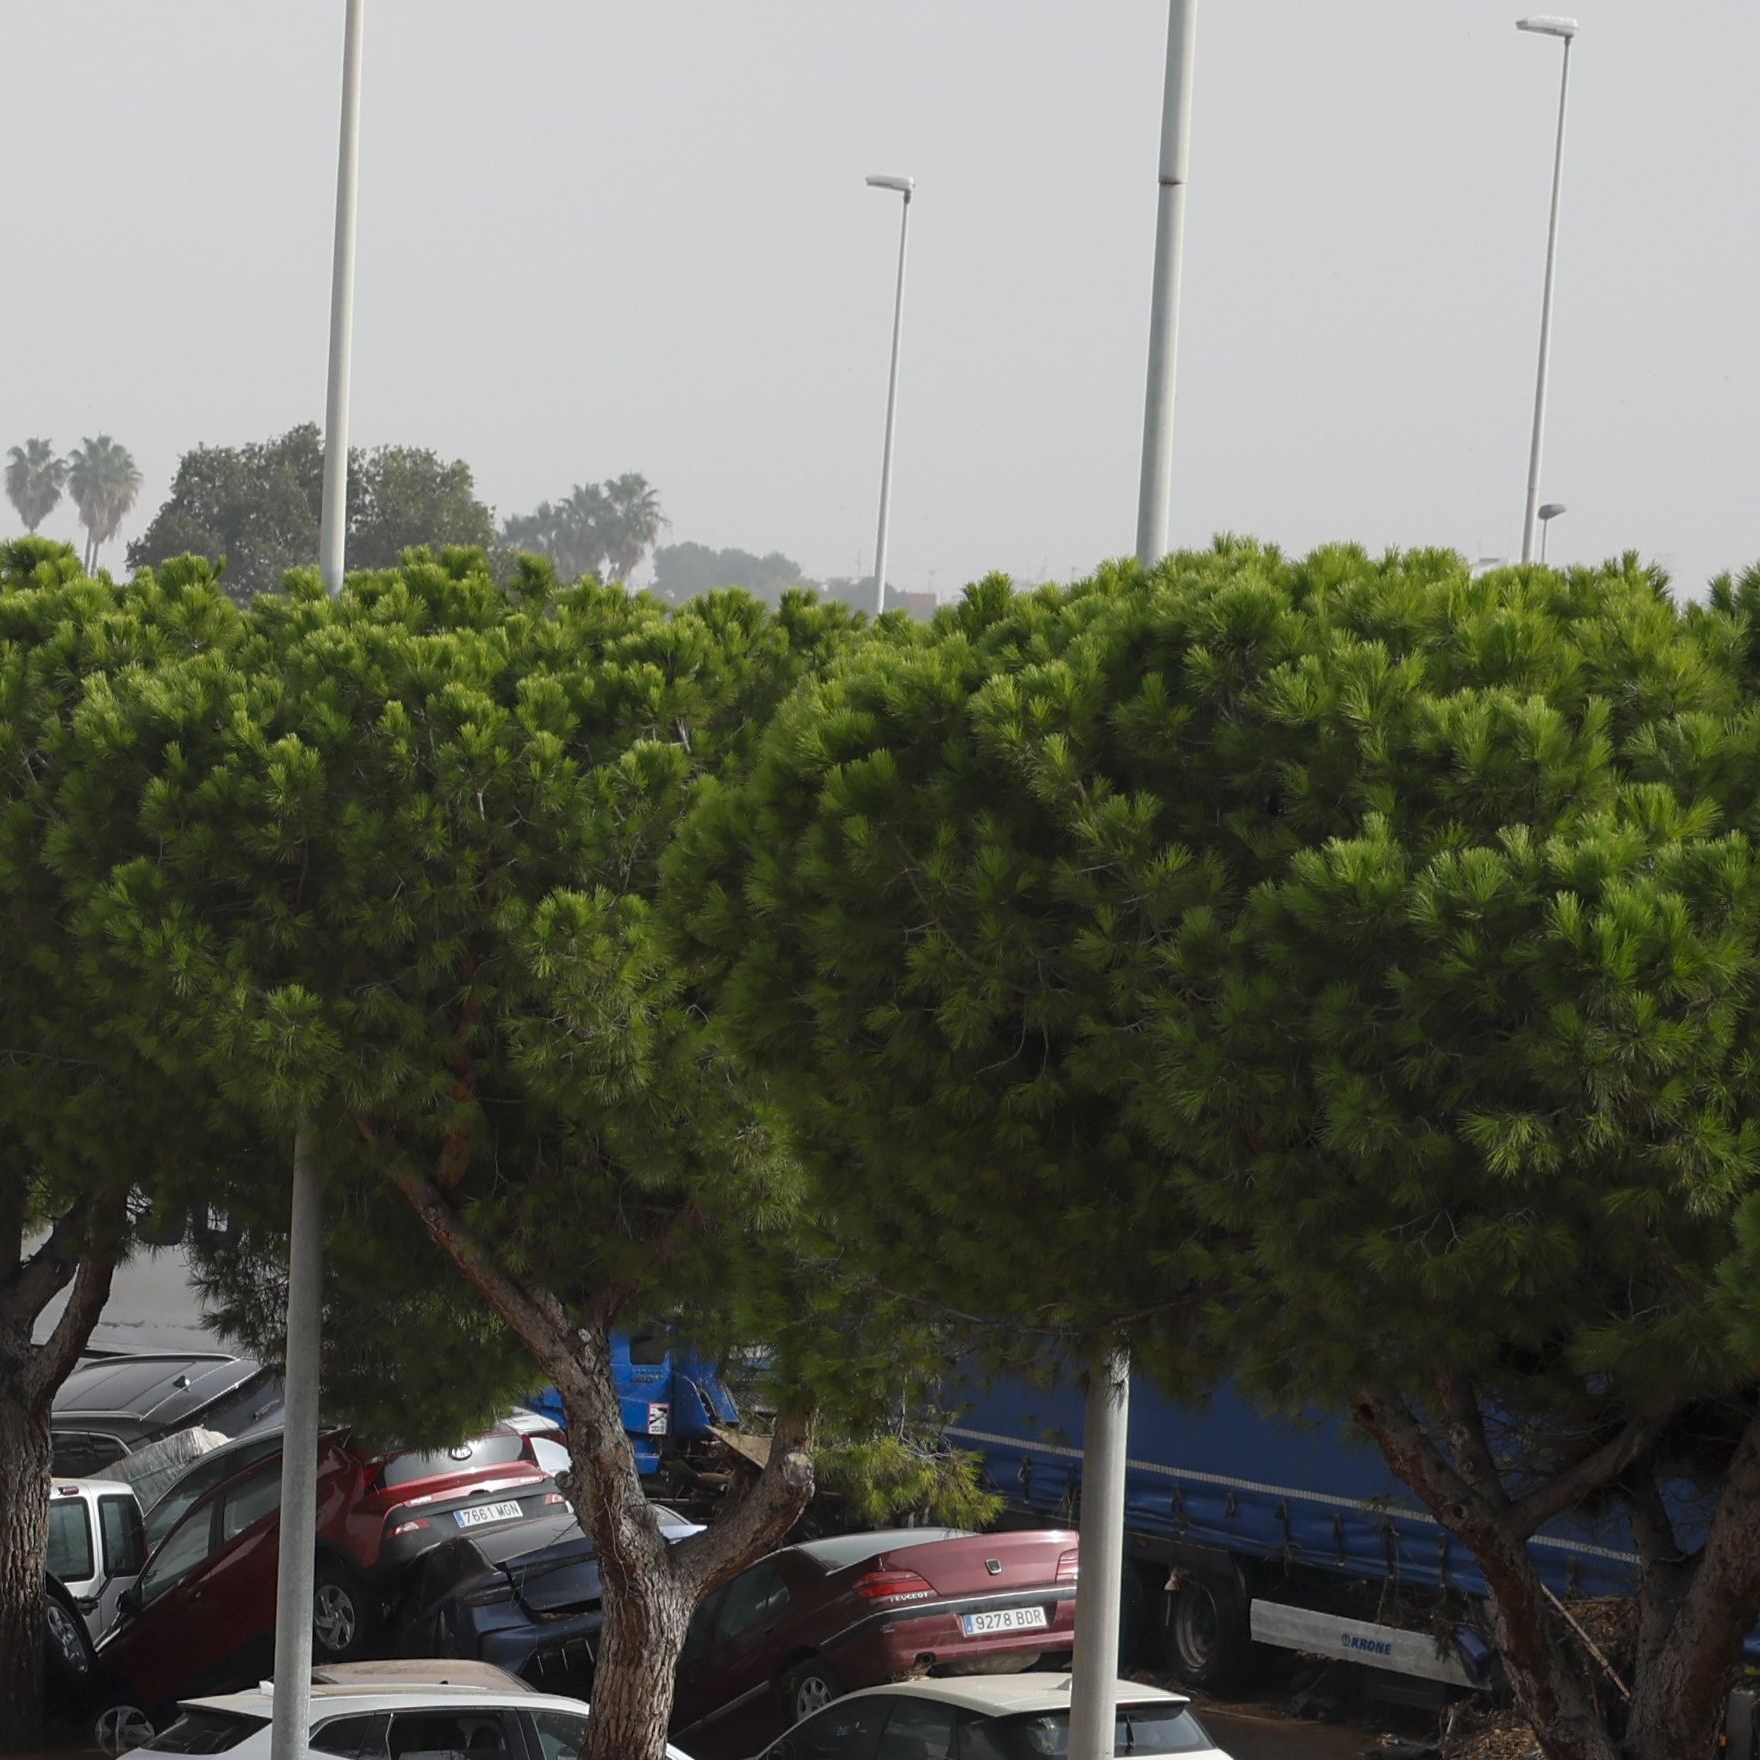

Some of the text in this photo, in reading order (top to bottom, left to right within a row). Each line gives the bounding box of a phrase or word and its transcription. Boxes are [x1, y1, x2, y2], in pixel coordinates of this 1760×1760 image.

[462, 1502, 521, 1524] 7661 MGN
[975, 1608, 1043, 1631] 9278 BDR
[1351, 1635, 1392, 1655] KRONE
